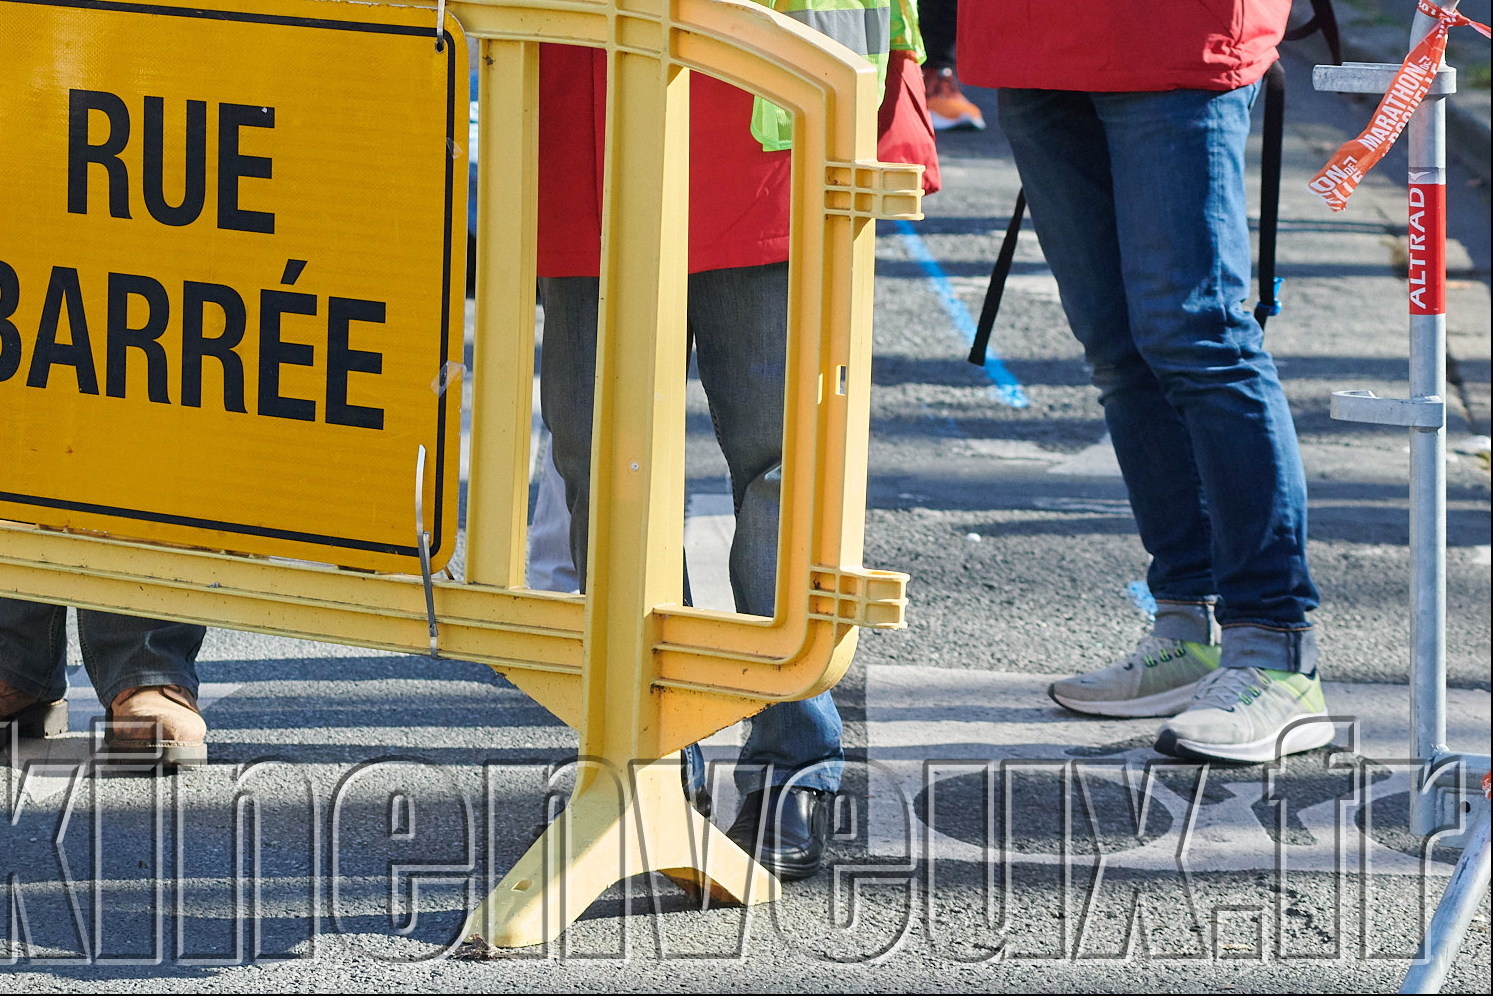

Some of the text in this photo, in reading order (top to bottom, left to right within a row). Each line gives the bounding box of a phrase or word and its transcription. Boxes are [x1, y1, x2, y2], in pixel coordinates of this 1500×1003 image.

[67, 88, 275, 234] RUE
[1357, 61, 1428, 152] MARATHON
[1409, 187, 1426, 310] ALTRAD
